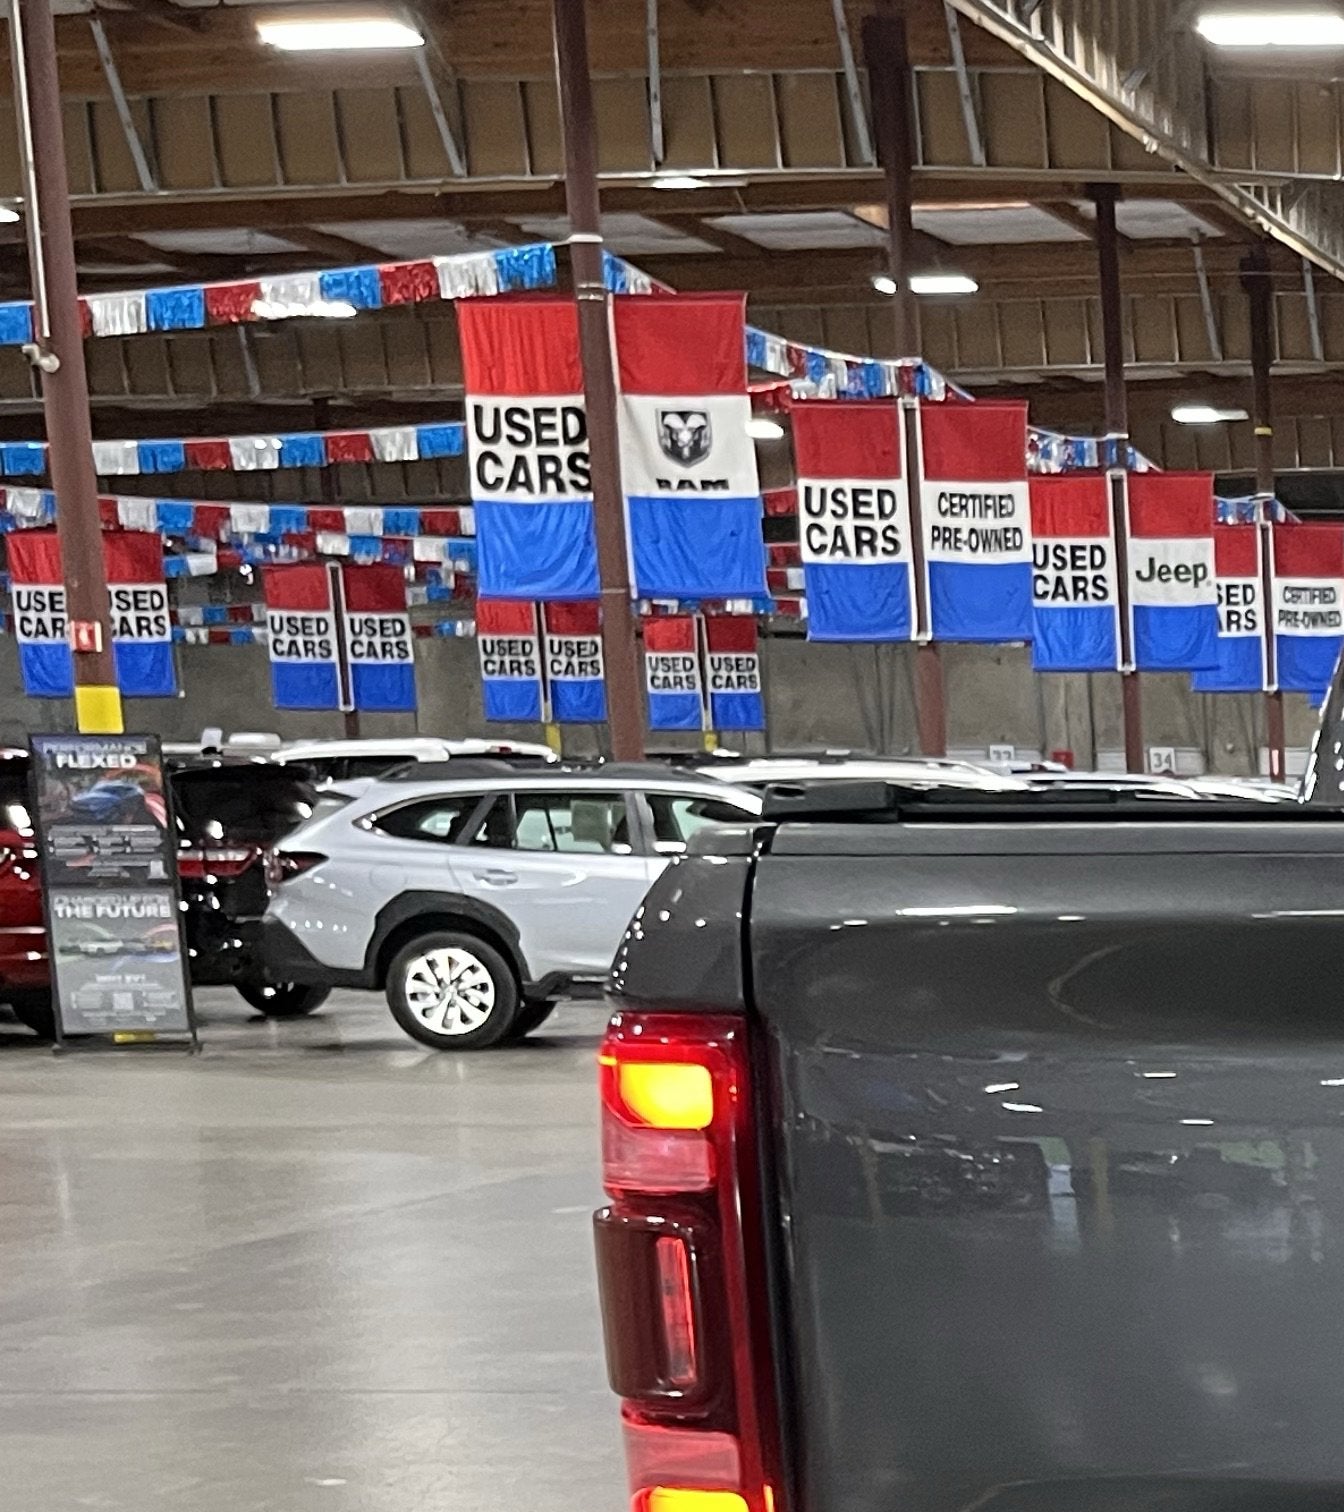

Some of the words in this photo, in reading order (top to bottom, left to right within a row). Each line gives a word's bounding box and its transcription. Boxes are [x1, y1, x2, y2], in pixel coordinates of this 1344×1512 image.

[473, 404, 587, 447] USED
[476, 451, 591, 494] CARS
[656, 479, 729, 491] RAM
[804, 486, 897, 520] USED
[938, 491, 1015, 519] CERTIFIED
[806, 522, 900, 557] CARS
[931, 525, 1023, 553] PRE-OWNED
[1032, 544, 1106, 571] USED
[1136, 557, 1207, 587] Jeep
[1033, 575, 1109, 601] CARS
[16, 590, 64, 612] USE
[109, 590, 164, 612] SED
[19, 616, 65, 638] CAR
[112, 616, 166, 637] ARS
[270, 616, 329, 636] USED
[350, 618, 406, 637] USED
[1278, 610, 1342, 628] PRE-OWNED
[272, 638, 332, 658] CARS
[350, 640, 409, 659] CARS
[481, 639, 534, 656] USED
[549, 639, 599, 657] USED
[483, 659, 536, 677] CARS
[550, 660, 600, 676] CARS
[649, 656, 695, 672] USED
[710, 656, 756, 672] USED
[650, 674, 696, 690] CARS
[711, 674, 758, 690] CARS
[55, 754, 138, 768] FLEXED
[54, 904, 91, 918] THE
[96, 904, 171, 918] FUTURE
